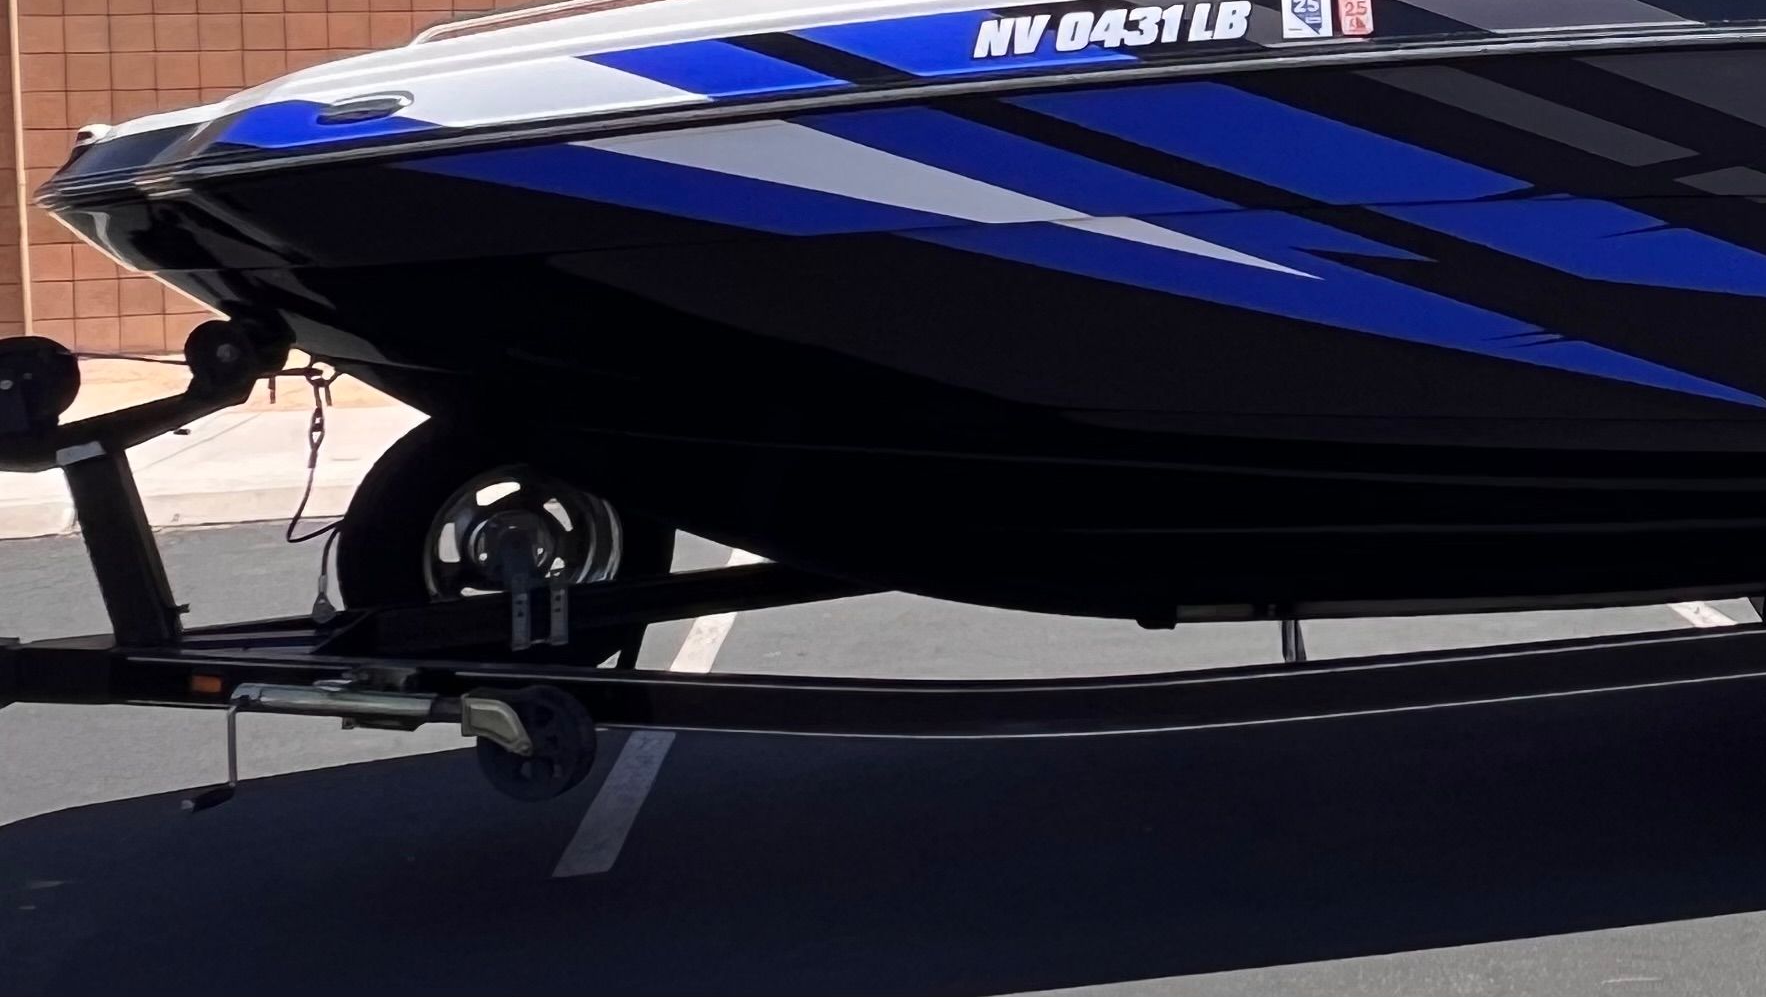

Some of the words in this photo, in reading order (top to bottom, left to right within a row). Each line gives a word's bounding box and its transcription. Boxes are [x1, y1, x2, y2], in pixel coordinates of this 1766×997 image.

[1344, 1, 1368, 16] 25
[973, 14, 1051, 58] NV
[1055, 4, 1184, 52] 0431
[1187, 0, 1252, 42] LB
